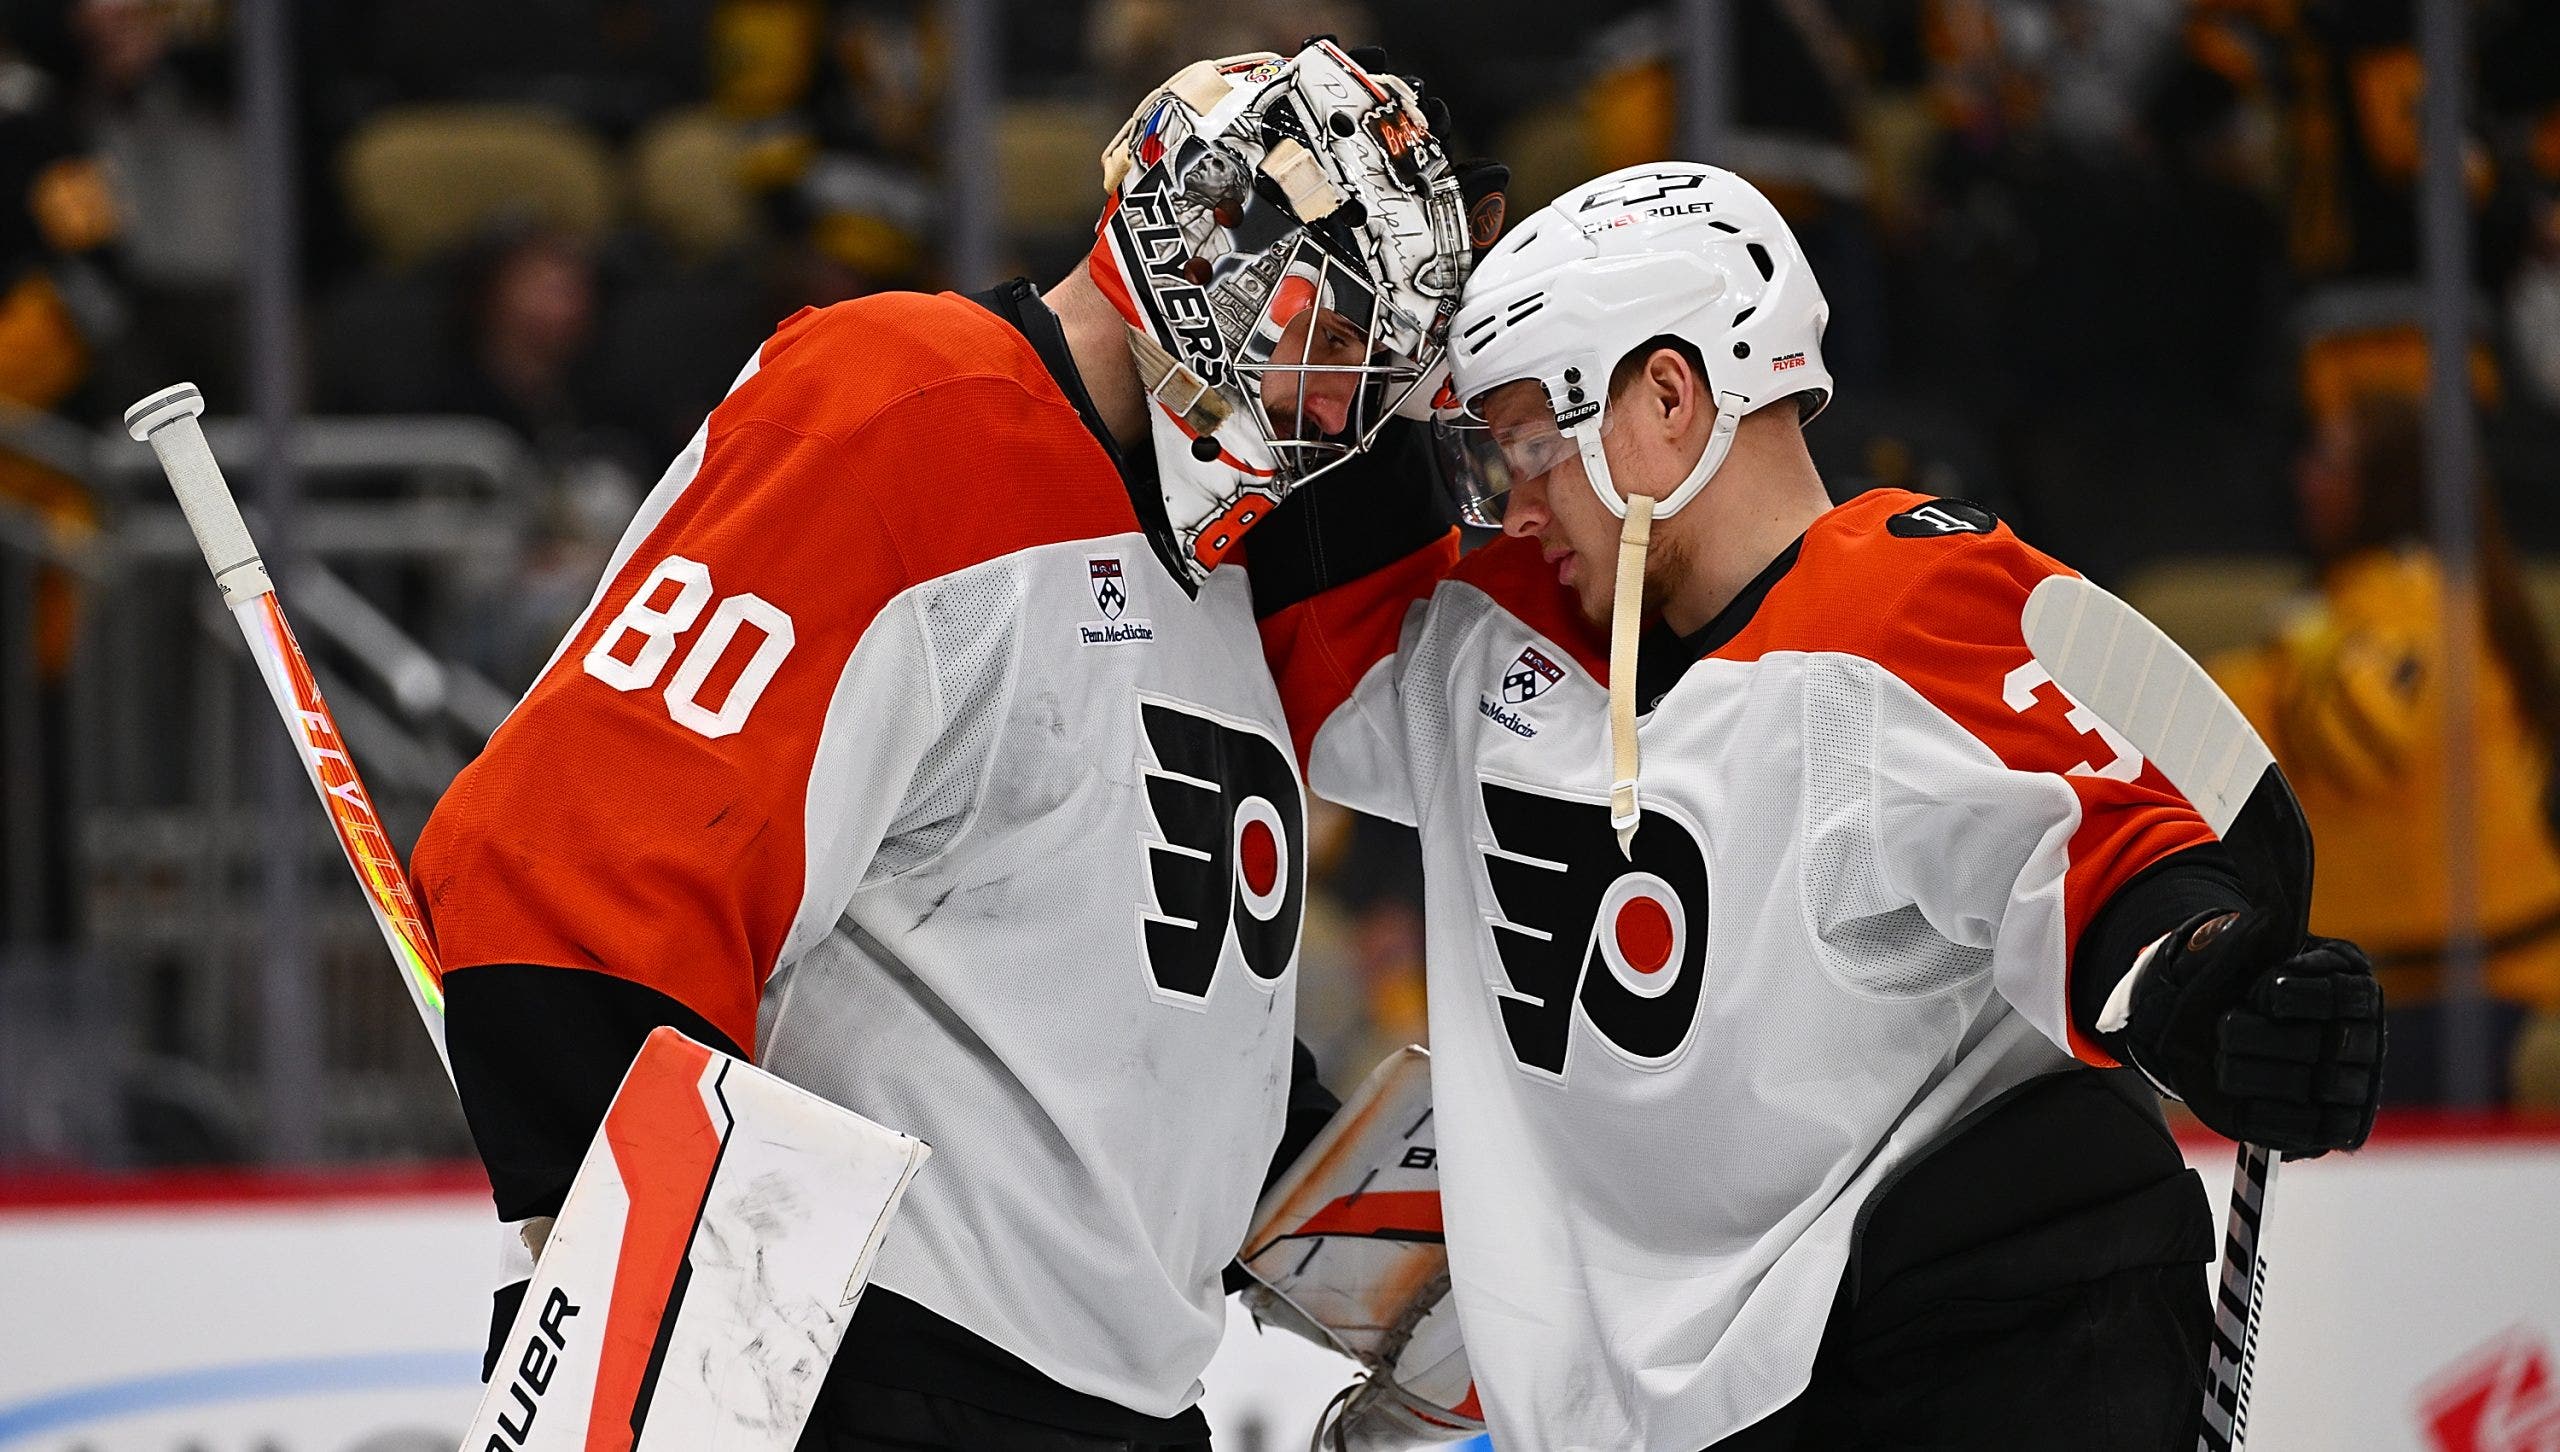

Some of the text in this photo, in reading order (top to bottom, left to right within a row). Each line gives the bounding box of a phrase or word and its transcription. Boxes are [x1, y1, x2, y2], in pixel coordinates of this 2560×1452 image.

[1124, 179, 1238, 388] FLYERS
[1772, 358, 1806, 371] FLYERS
[1911, 506, 1978, 532] 1
[582, 554, 796, 740] 80
[1081, 623, 1153, 644] Penn Medicine
[484, 1286, 581, 1452] UER
[2234, 1254, 2268, 1446] WARRIOR
